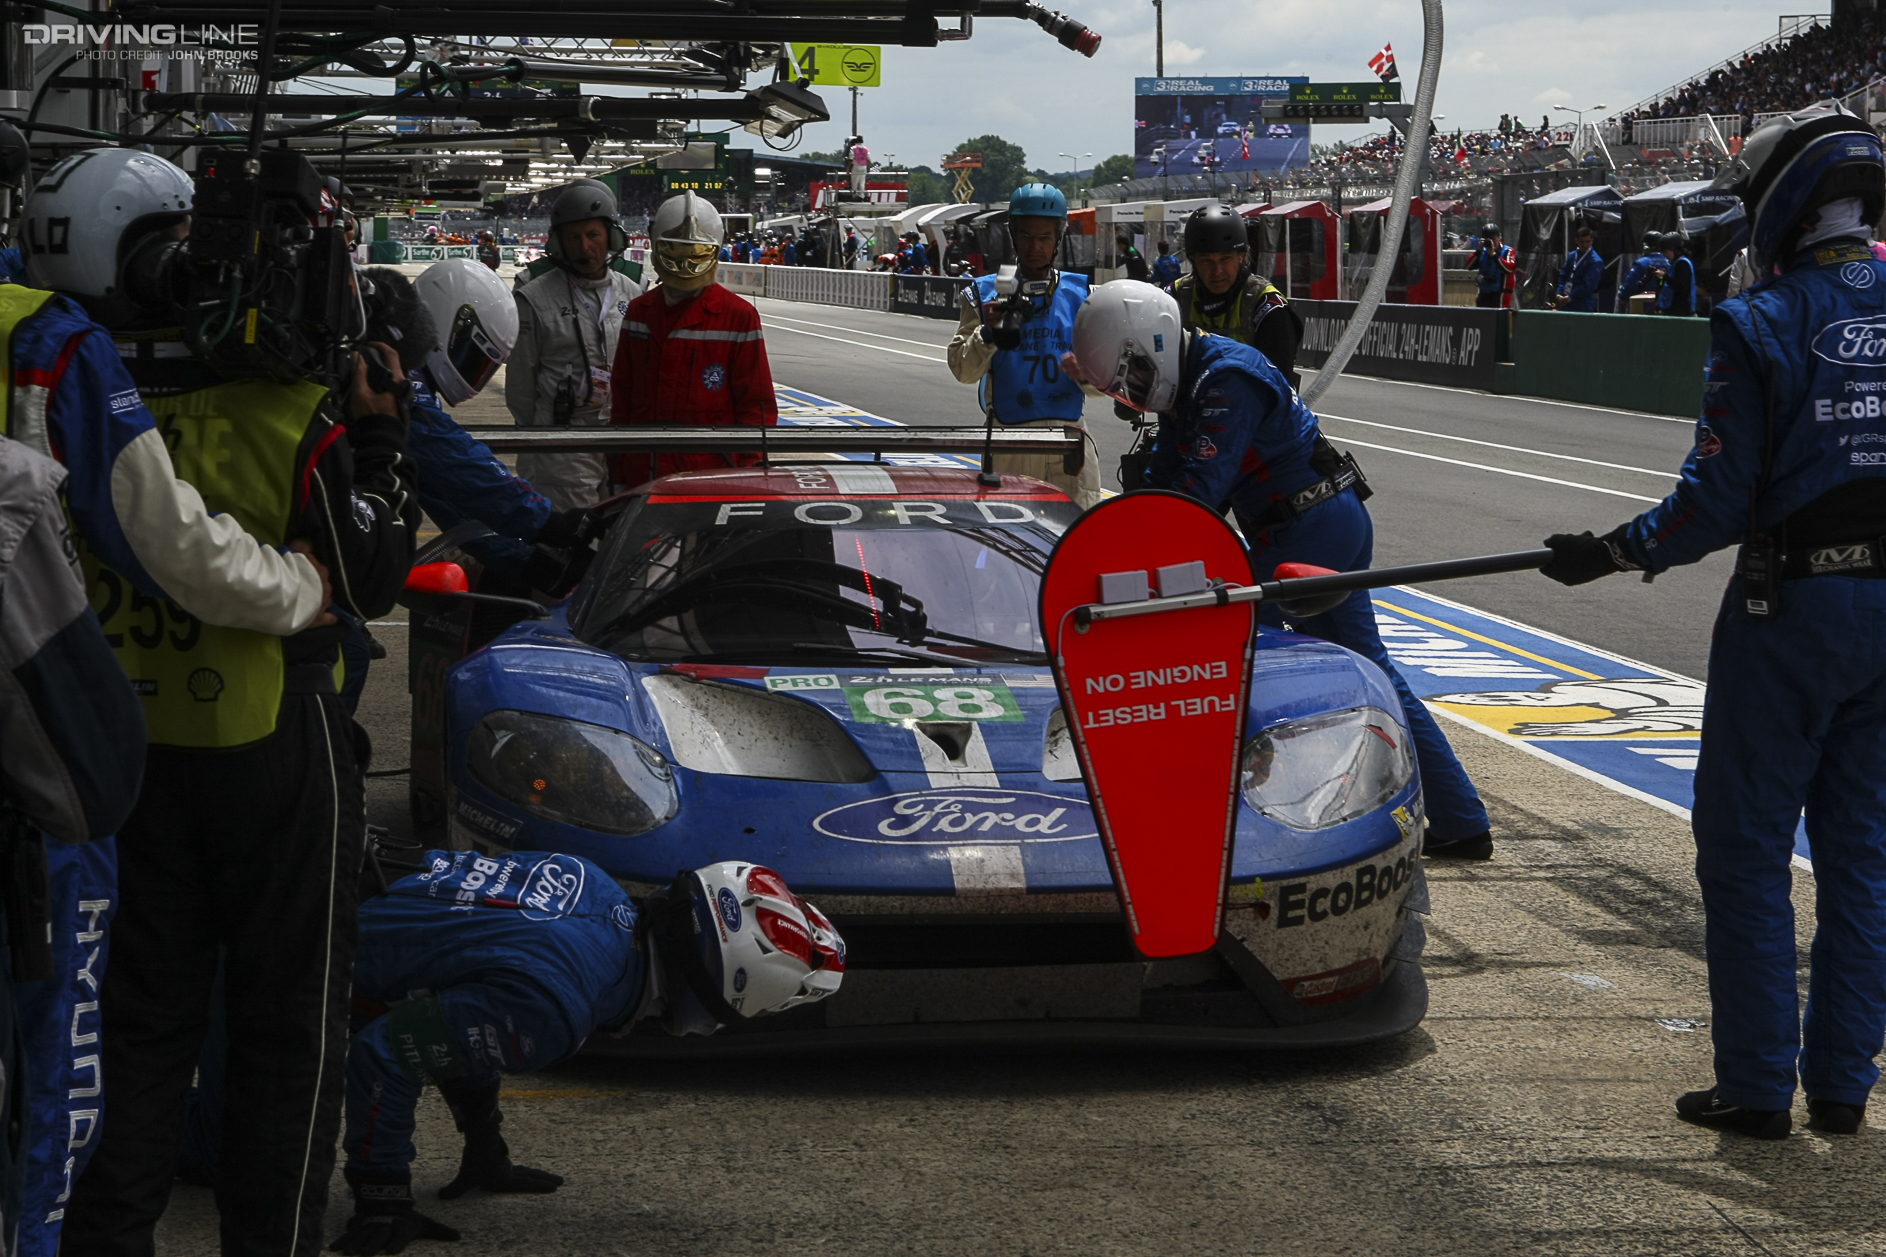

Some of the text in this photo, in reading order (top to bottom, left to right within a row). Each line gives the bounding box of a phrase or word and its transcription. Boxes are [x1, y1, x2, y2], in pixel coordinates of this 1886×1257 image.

[794, 46, 820, 82] 4
[1555, 130, 1570, 141] 22
[1022, 327, 1061, 340] MEDIA
[1361, 320, 1400, 359] OFFICIAL
[1458, 327, 1481, 367] APP
[1022, 354, 1060, 385] 70
[714, 501, 1037, 526] FORD
[1811, 557, 1873, 575] MECHANIX WEAR
[93, 567, 202, 653] 259
[769, 675, 835, 691] PRO
[1085, 660, 1228, 695] ENGINE ON
[863, 687, 1005, 720] 68
[1083, 693, 1237, 730] FUEL RESET
[458, 800, 517, 840] MICHELIN
[877, 796, 1068, 837] Ford
[524, 863, 578, 912] Ford
[1276, 847, 1418, 930] EcoBoos
[712, 897, 729, 944] PERFORMANCE
[1305, 979, 1336, 996] Castrol
[467, 1026, 485, 1048] IHG
